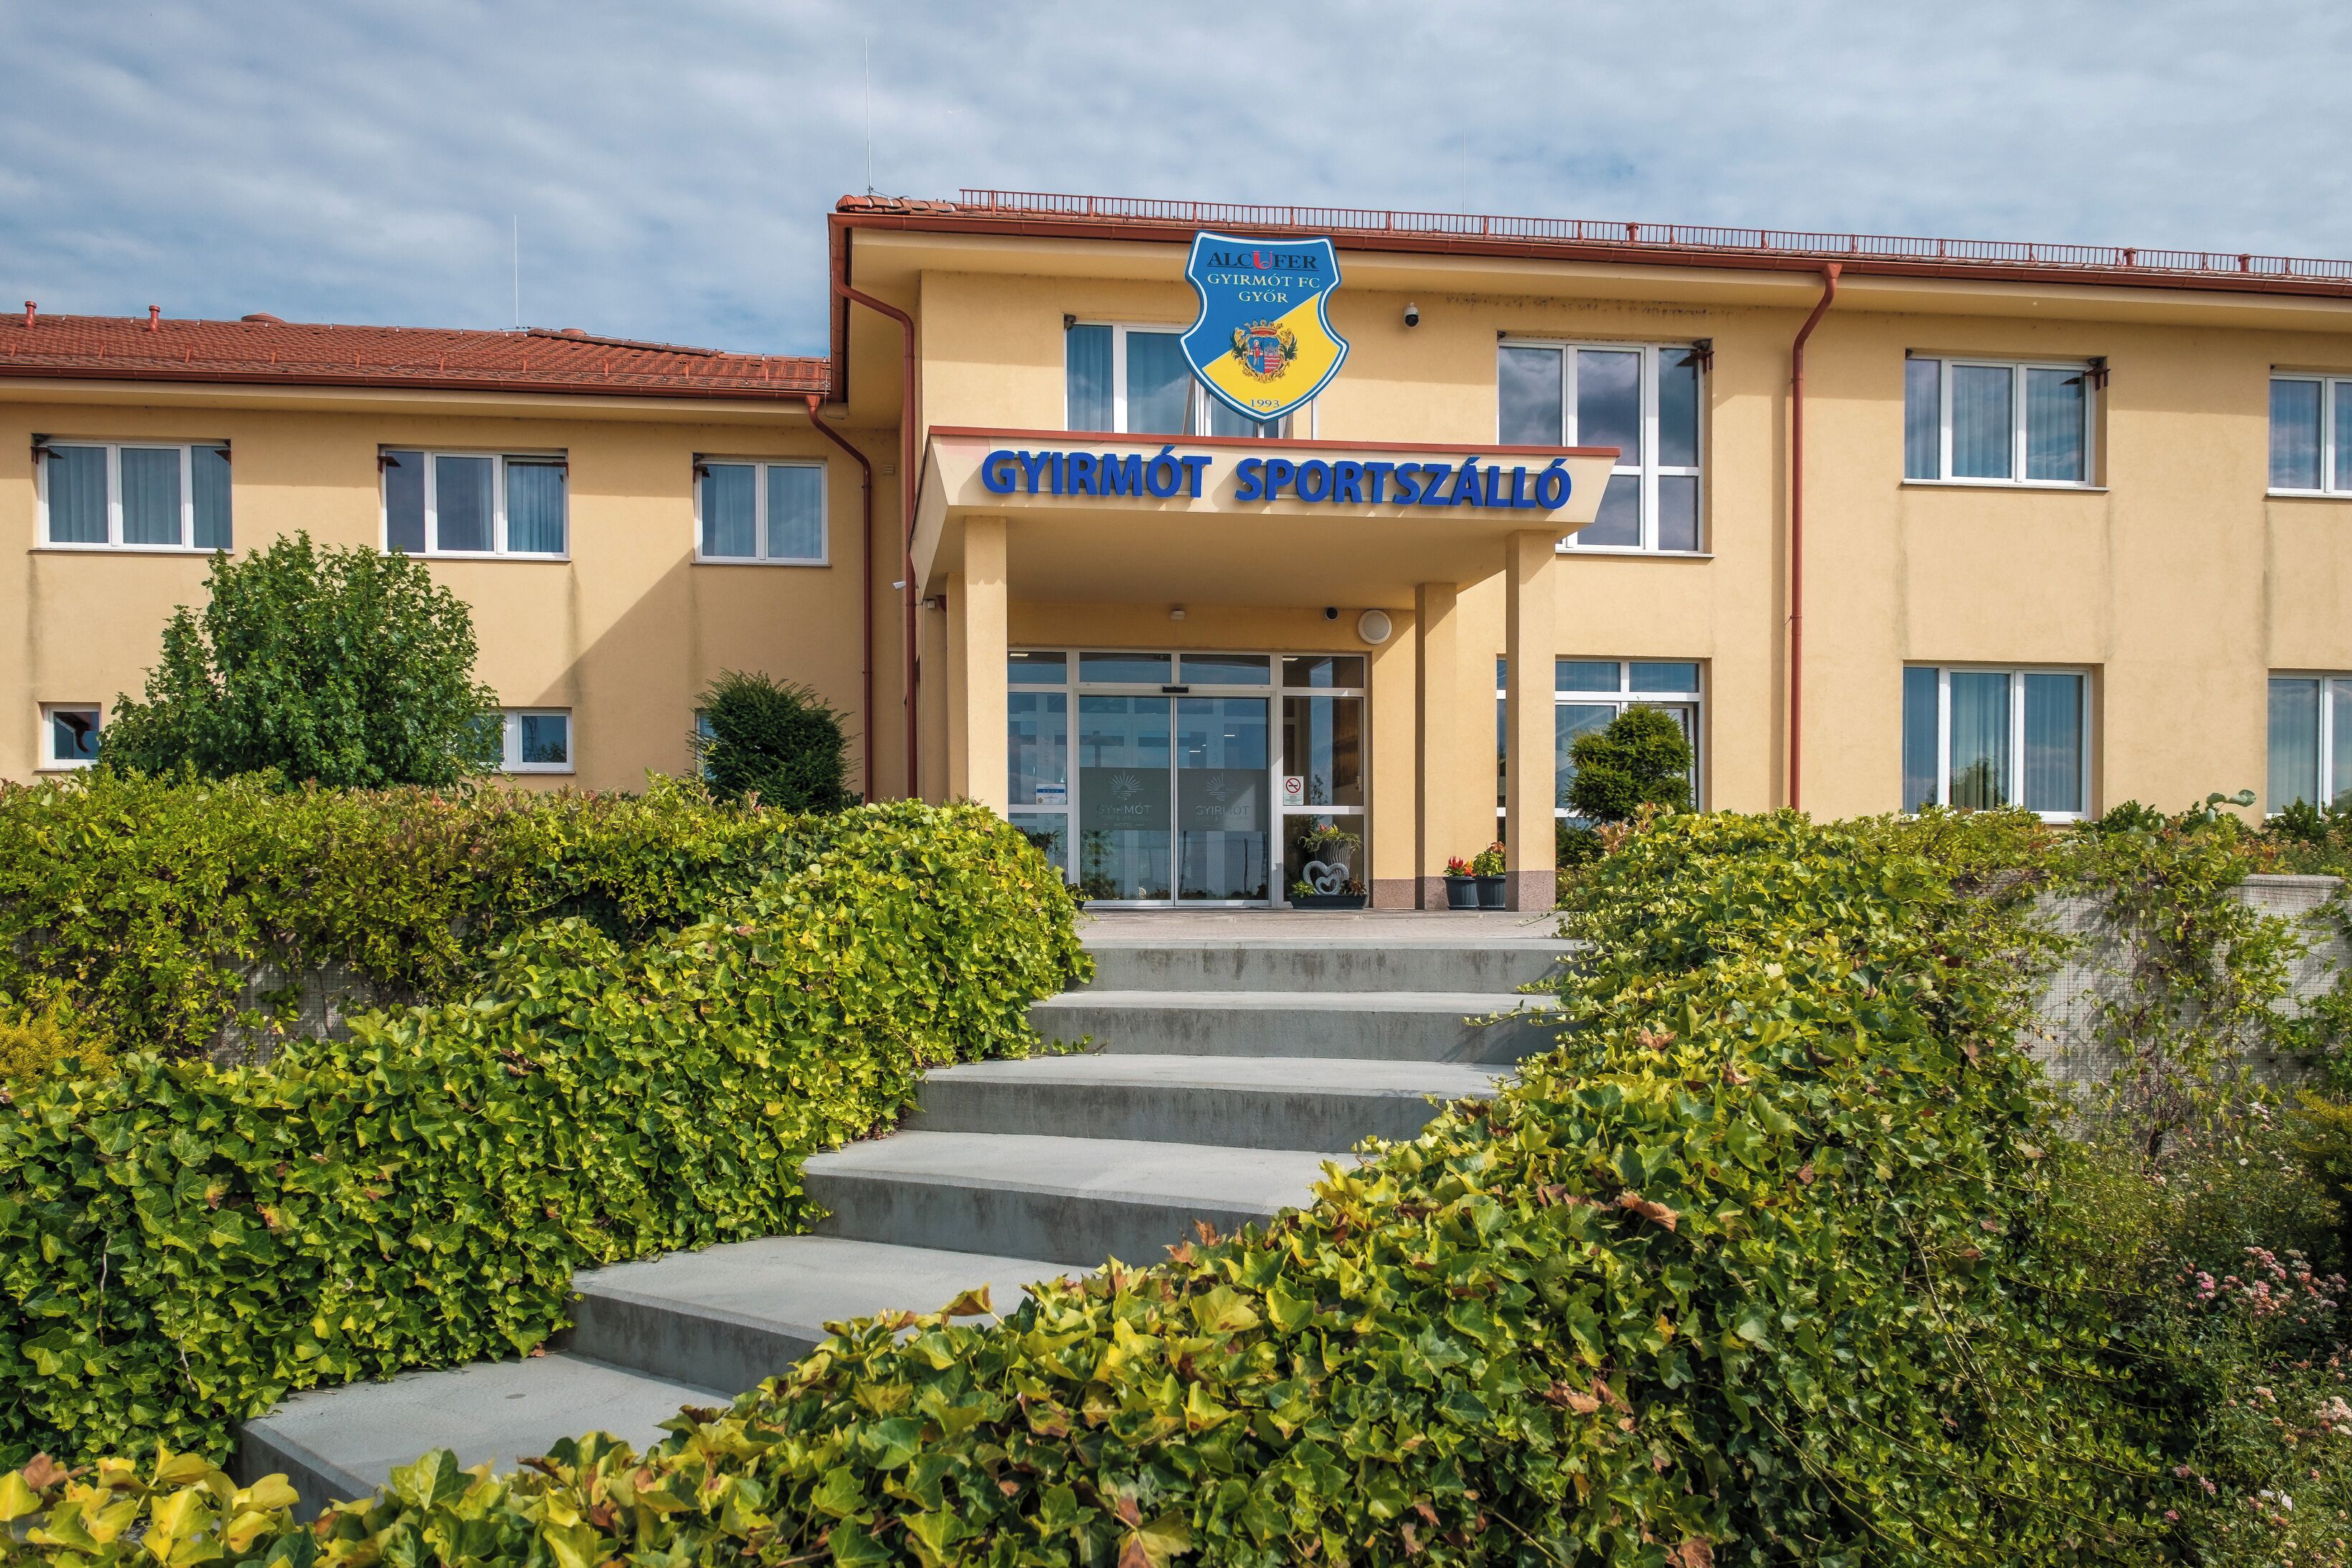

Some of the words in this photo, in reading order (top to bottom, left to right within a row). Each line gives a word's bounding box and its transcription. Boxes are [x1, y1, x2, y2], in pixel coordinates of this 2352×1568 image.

[1208, 251, 1317, 270] ALCUFER
[1208, 273, 1293, 288] GYIRMÓT
[1298, 277, 1320, 288] FC
[1238, 289, 1289, 303] GYŐR
[1251, 399, 1280, 408] 1993
[982, 444, 1213, 499] GYIRMÓT
[1235, 456, 1572, 511] SPORTSZÁLLÓ
